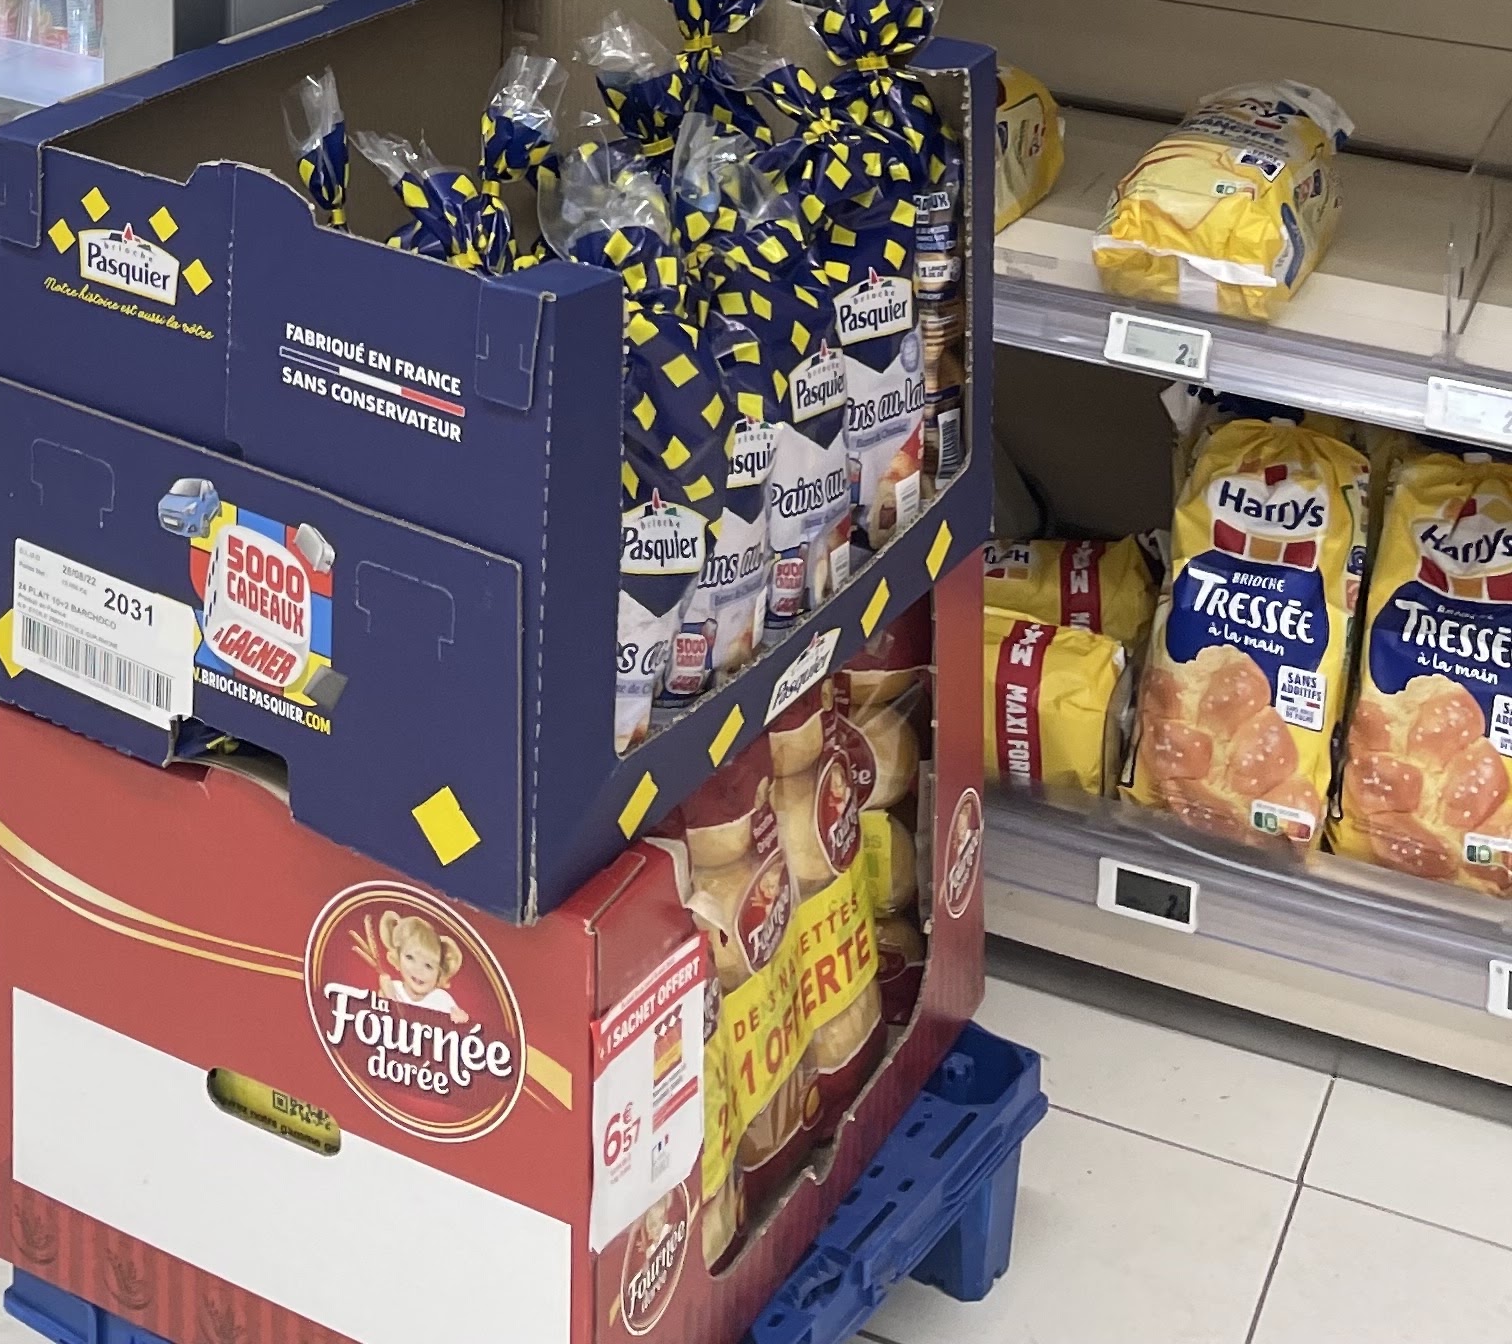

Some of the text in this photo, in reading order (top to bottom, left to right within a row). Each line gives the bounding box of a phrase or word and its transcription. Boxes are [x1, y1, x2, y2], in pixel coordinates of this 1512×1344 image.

[86, 242, 171, 291] Pasquier
[103, 241, 156, 264] brioche
[43, 276, 78, 299] Notre
[78, 285, 121, 314] histoire
[120, 301, 138, 317] est
[138, 307, 165, 326] aussi
[165, 314, 181, 331] la
[839, 297, 909, 334] Pasquier
[285, 322, 462, 397] FABRIQUÉ EN FRANCE
[281, 366, 463, 443] SANS CONSERVATEUR
[1218, 480, 1325, 530] Harrys
[226, 536, 305, 602] 5000
[622, 525, 698, 568] Pasquier
[102, 586, 155, 627] 2031
[226, 572, 305, 638] CADEAUX
[1188, 567, 1315, 644] TRESSÉE
[1231, 571, 1286, 593] BRIOCHE
[218, 624, 298, 686] GAGNER
[1208, 623, 1285, 657] à la main
[1287, 671, 1317, 689] SANS
[1417, 653, 1499, 684] à la main
[1006, 684, 1029, 739] MAXI
[371, 991, 391, 1012] la
[613, 996, 656, 1049] SACHET
[655, 958, 702, 1007] OFFERT
[734, 1009, 760, 1042] DE
[740, 1055, 756, 1096] 1
[764, 923, 872, 1074] OFFERTE
[322, 982, 512, 1087] Fournée
[367, 1047, 450, 1094] dorée
